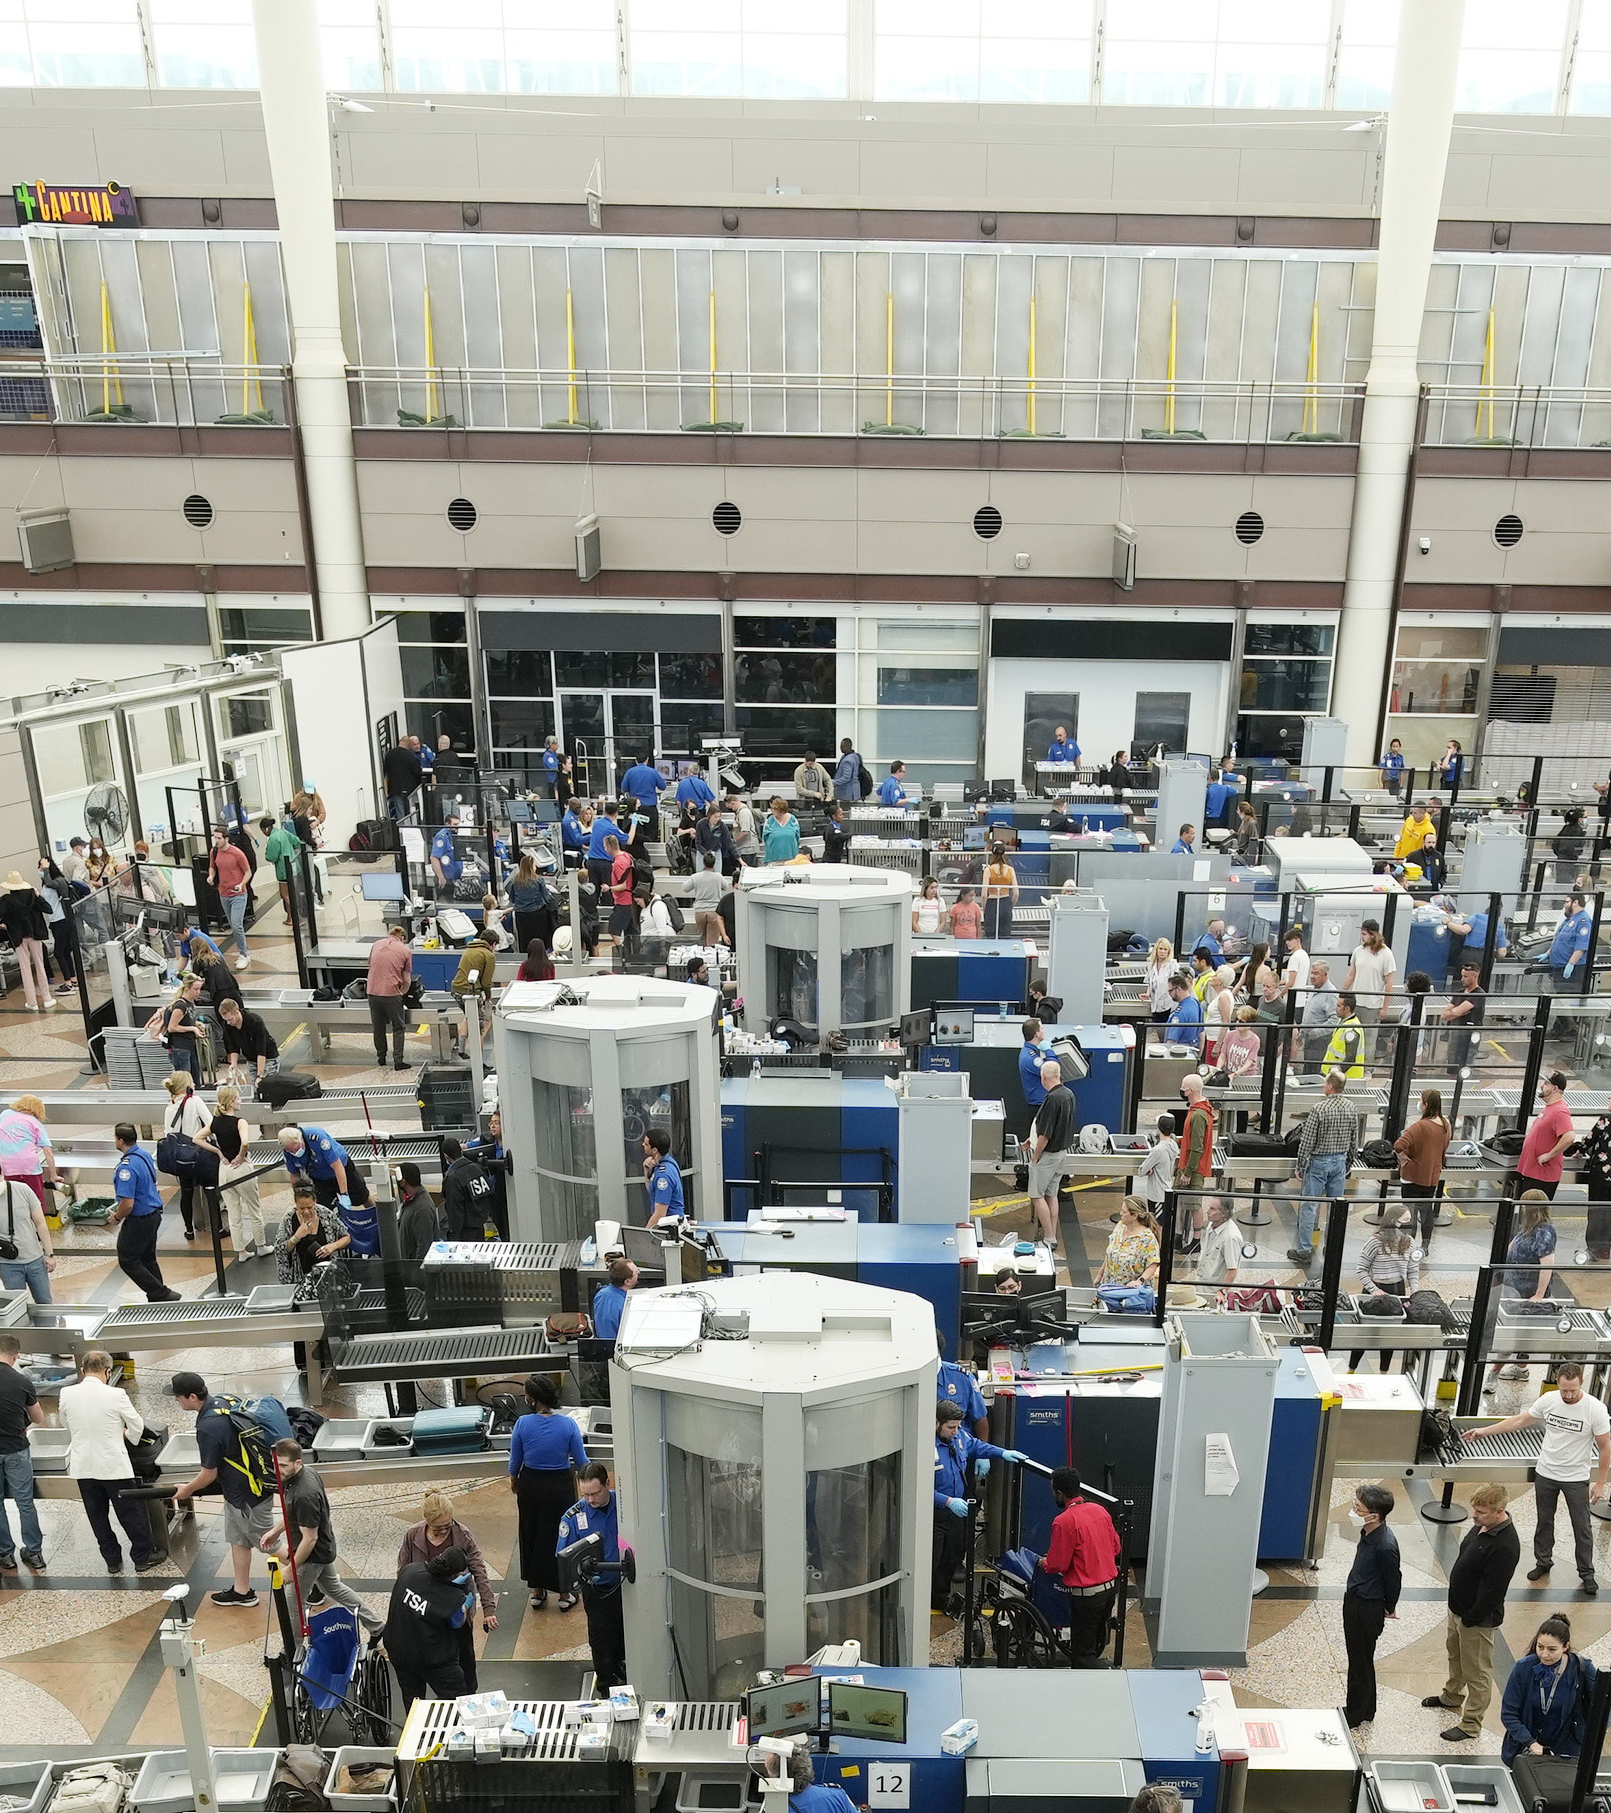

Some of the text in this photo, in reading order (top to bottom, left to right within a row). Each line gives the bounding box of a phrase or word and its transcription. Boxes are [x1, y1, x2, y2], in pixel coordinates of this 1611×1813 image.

[35, 179, 114, 222] CANTINA
[1040, 818, 1050, 827] TSA
[403, 1588, 428, 1616] TSA
[876, 1775, 903, 1793] 12
[1160, 1780, 1199, 1788] smiths
